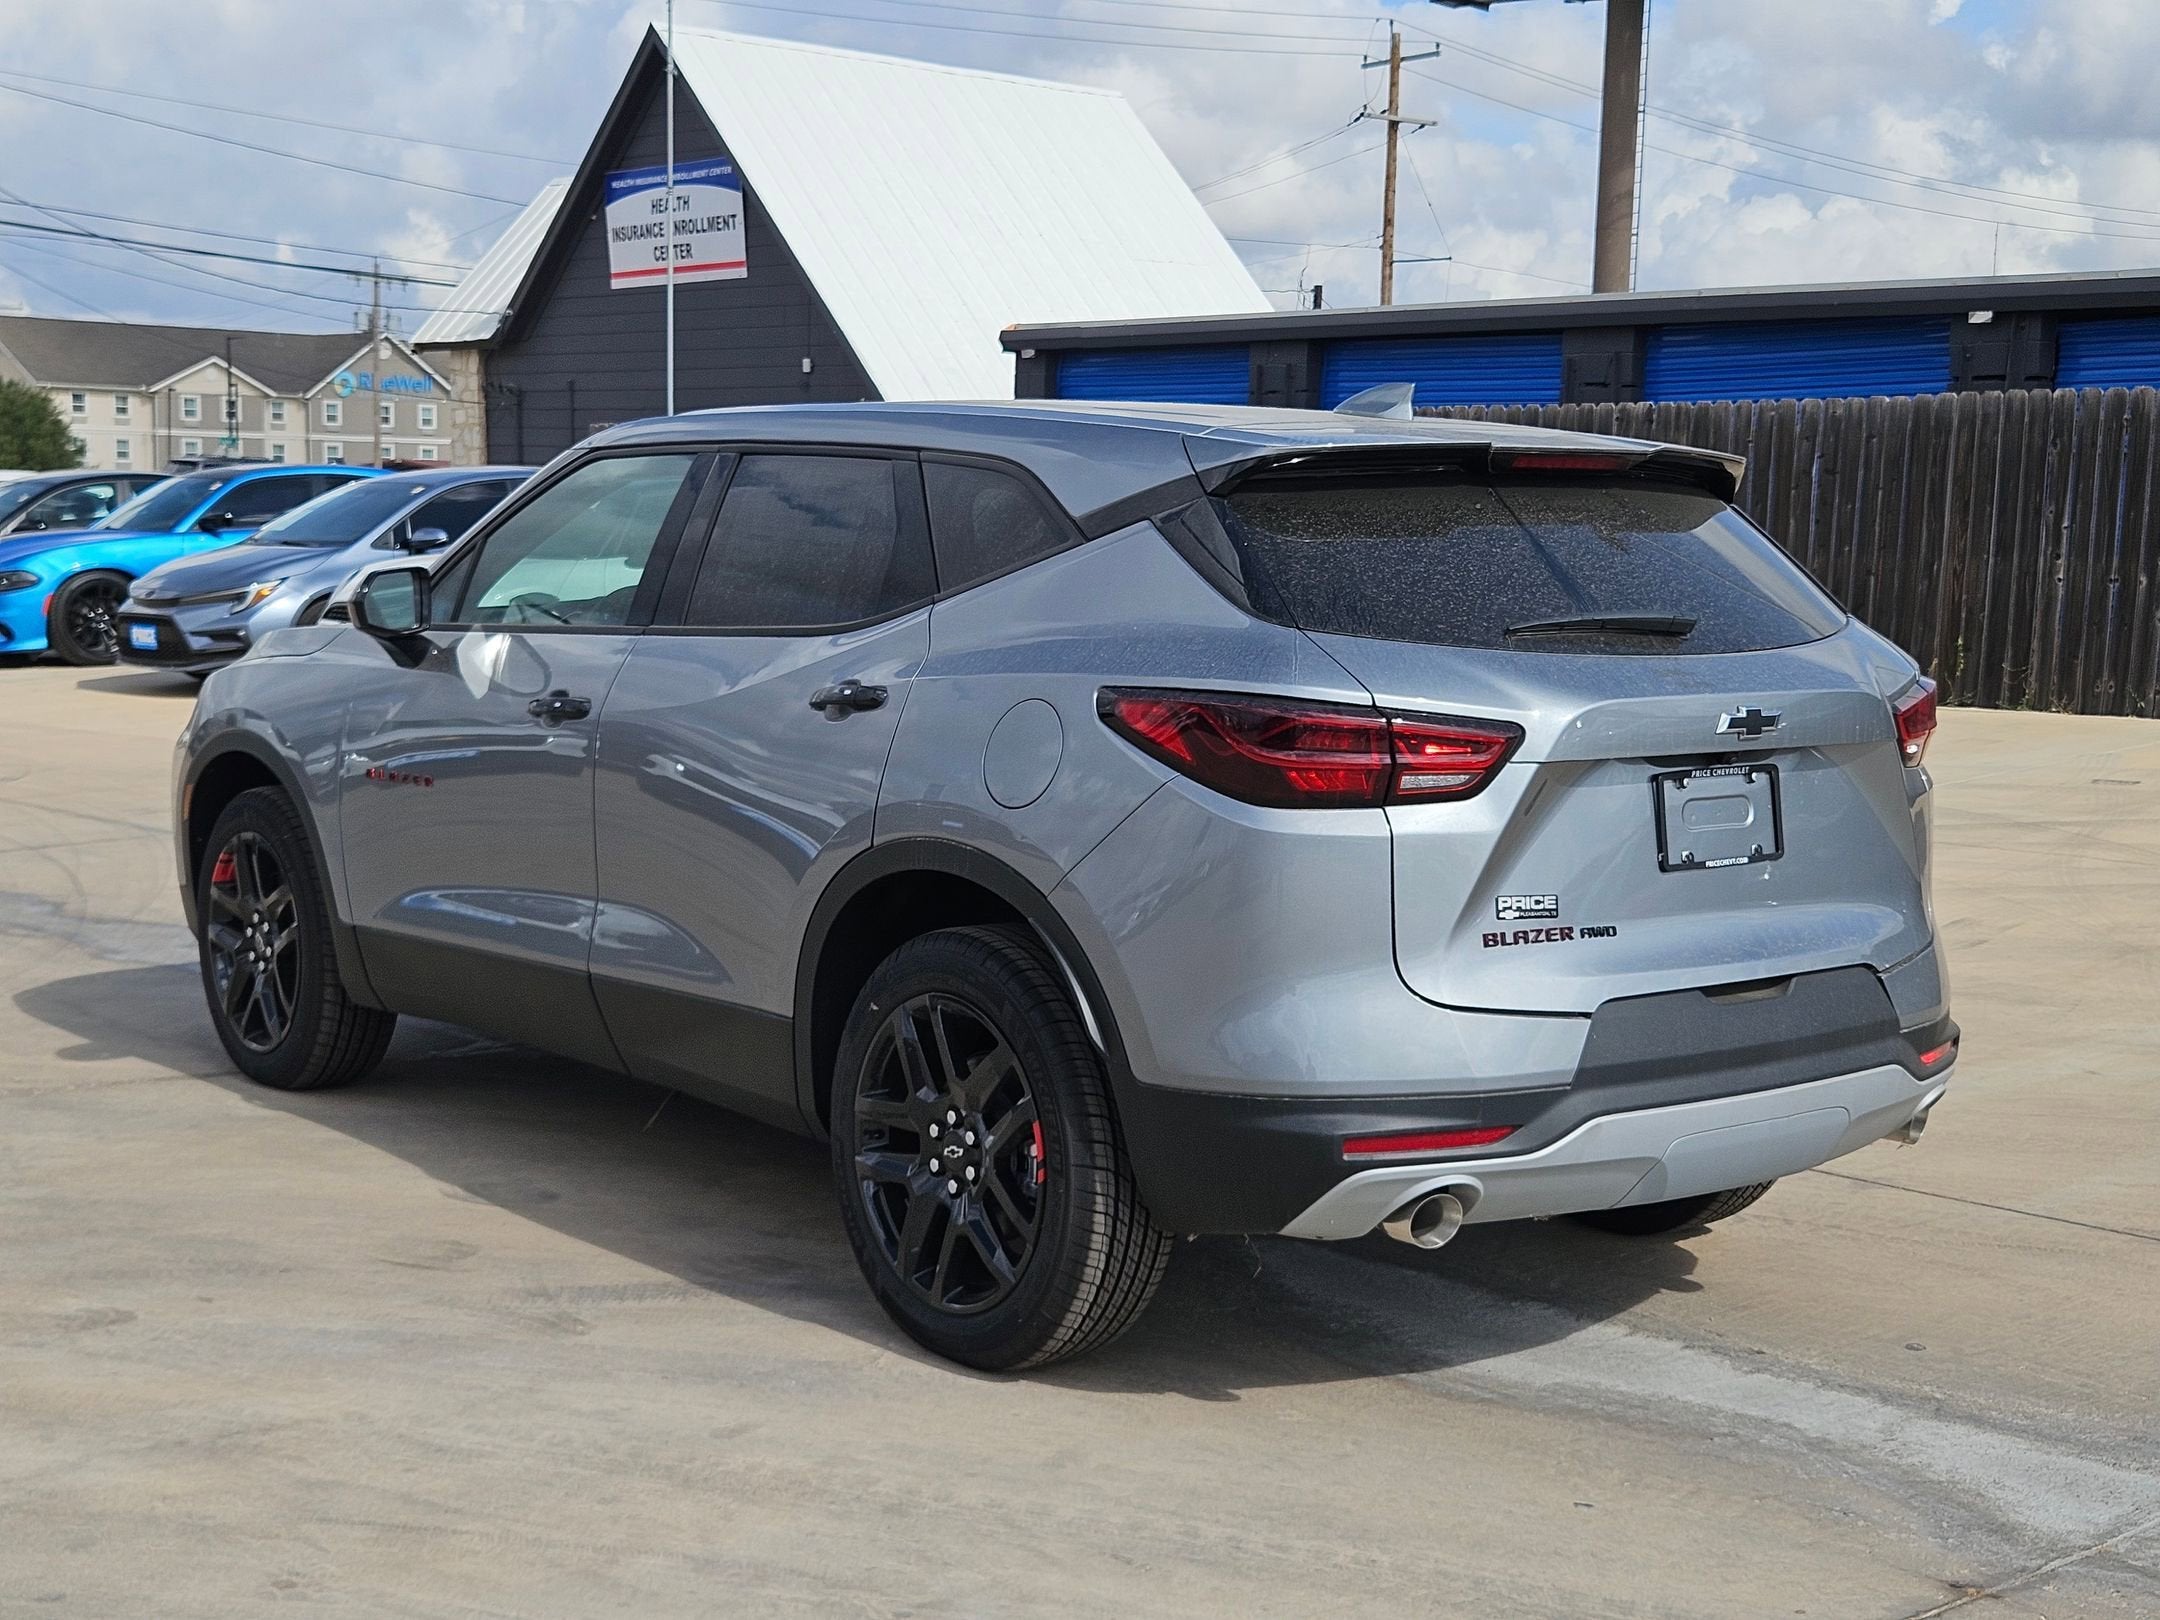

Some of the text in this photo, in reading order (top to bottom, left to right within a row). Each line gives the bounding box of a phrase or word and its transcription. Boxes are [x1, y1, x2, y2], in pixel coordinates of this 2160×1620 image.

[612, 214, 737, 243] INSURANCE NROLLMENT
[359, 371, 433, 393] BleWell
[1691, 767, 1750, 778] PRICE CHEVROLET
[1498, 895, 1557, 910] PRICE
[1482, 926, 1617, 948] BLAZER AWD
